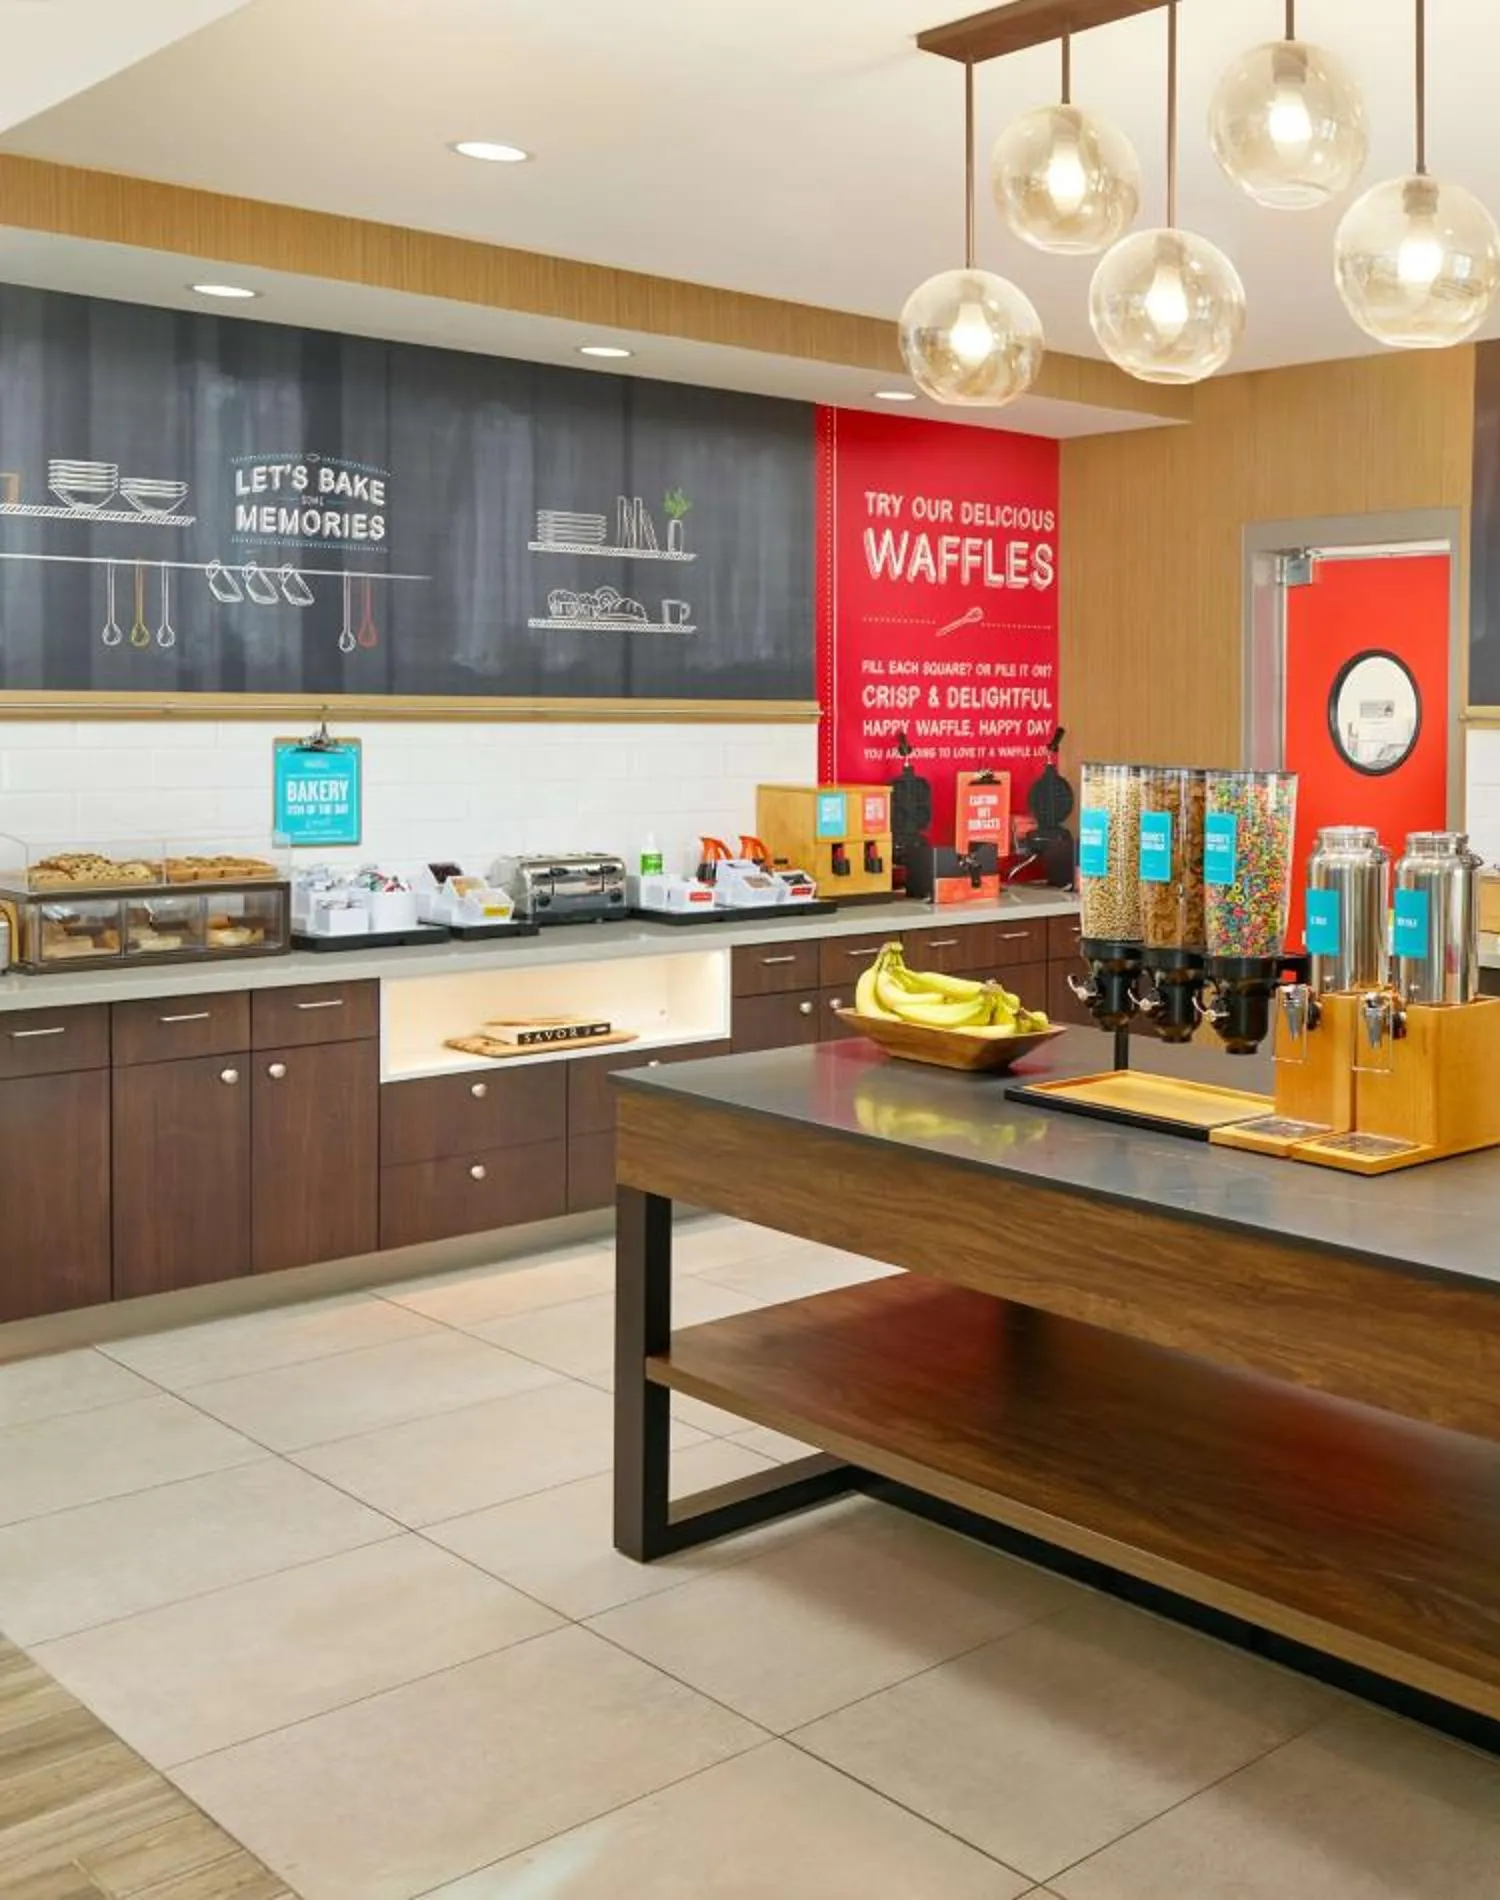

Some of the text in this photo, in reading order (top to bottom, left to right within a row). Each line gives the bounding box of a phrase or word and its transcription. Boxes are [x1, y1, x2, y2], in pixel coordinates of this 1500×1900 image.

[235, 463, 385, 506] LET'S BAKE
[235, 504, 385, 541] MEMORIES
[864, 491, 1056, 533] TRY OUR DELICIOUS
[863, 527, 1054, 592] WAFFLES
[862, 660, 884, 674] FILL
[889, 660, 919, 676] EACH
[922, 661, 973, 677] SQUARE?
[976, 663, 991, 676] OR
[996, 664, 1017, 677] PILE
[1019, 664, 1029, 677] IT
[862, 685, 1052, 710] CRISP & DELIGHTFUL
[863, 720, 910, 737] HAPPY
[979, 720, 1022, 737] HAPPY
[1027, 720, 1052, 736] DAY
[864, 748, 882, 760] YOU
[938, 747, 951, 759] TO
[953, 747, 976, 759] LOVE
[287, 780, 349, 802] BAKERY
[524, 1026, 577, 1043] SAVOR
